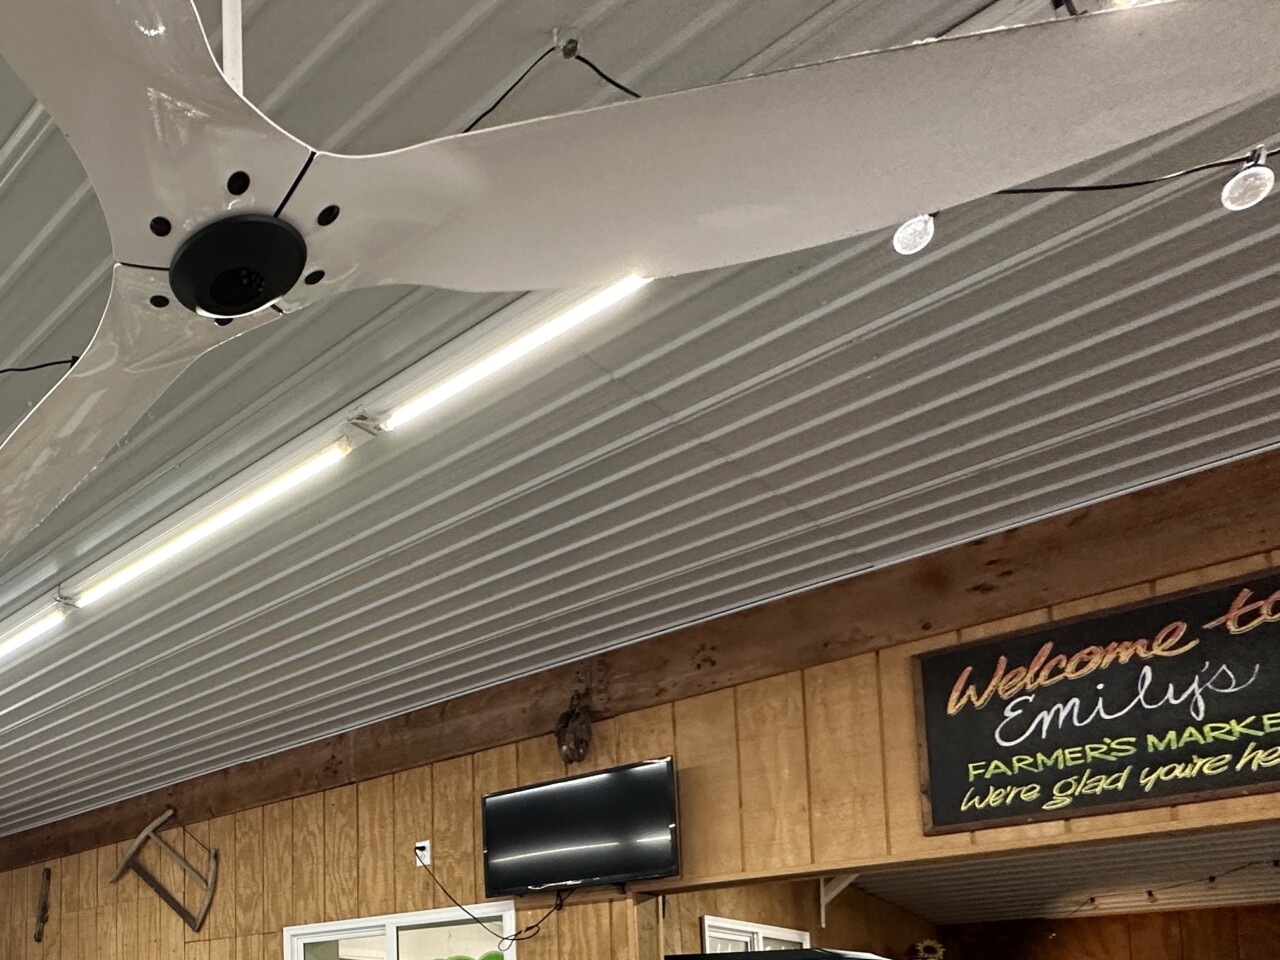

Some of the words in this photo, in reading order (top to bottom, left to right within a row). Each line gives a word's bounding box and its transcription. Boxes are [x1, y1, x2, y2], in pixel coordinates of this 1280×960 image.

[946, 620, 1200, 716] Welcome
[994, 660, 1260, 747] Emily's
[960, 781, 1040, 812] We're
[1041, 765, 1132, 810] glad
[1235, 741, 1280, 772] he
[967, 736, 1137, 783] FARMER'S
[1146, 710, 1280, 752] MARKE
